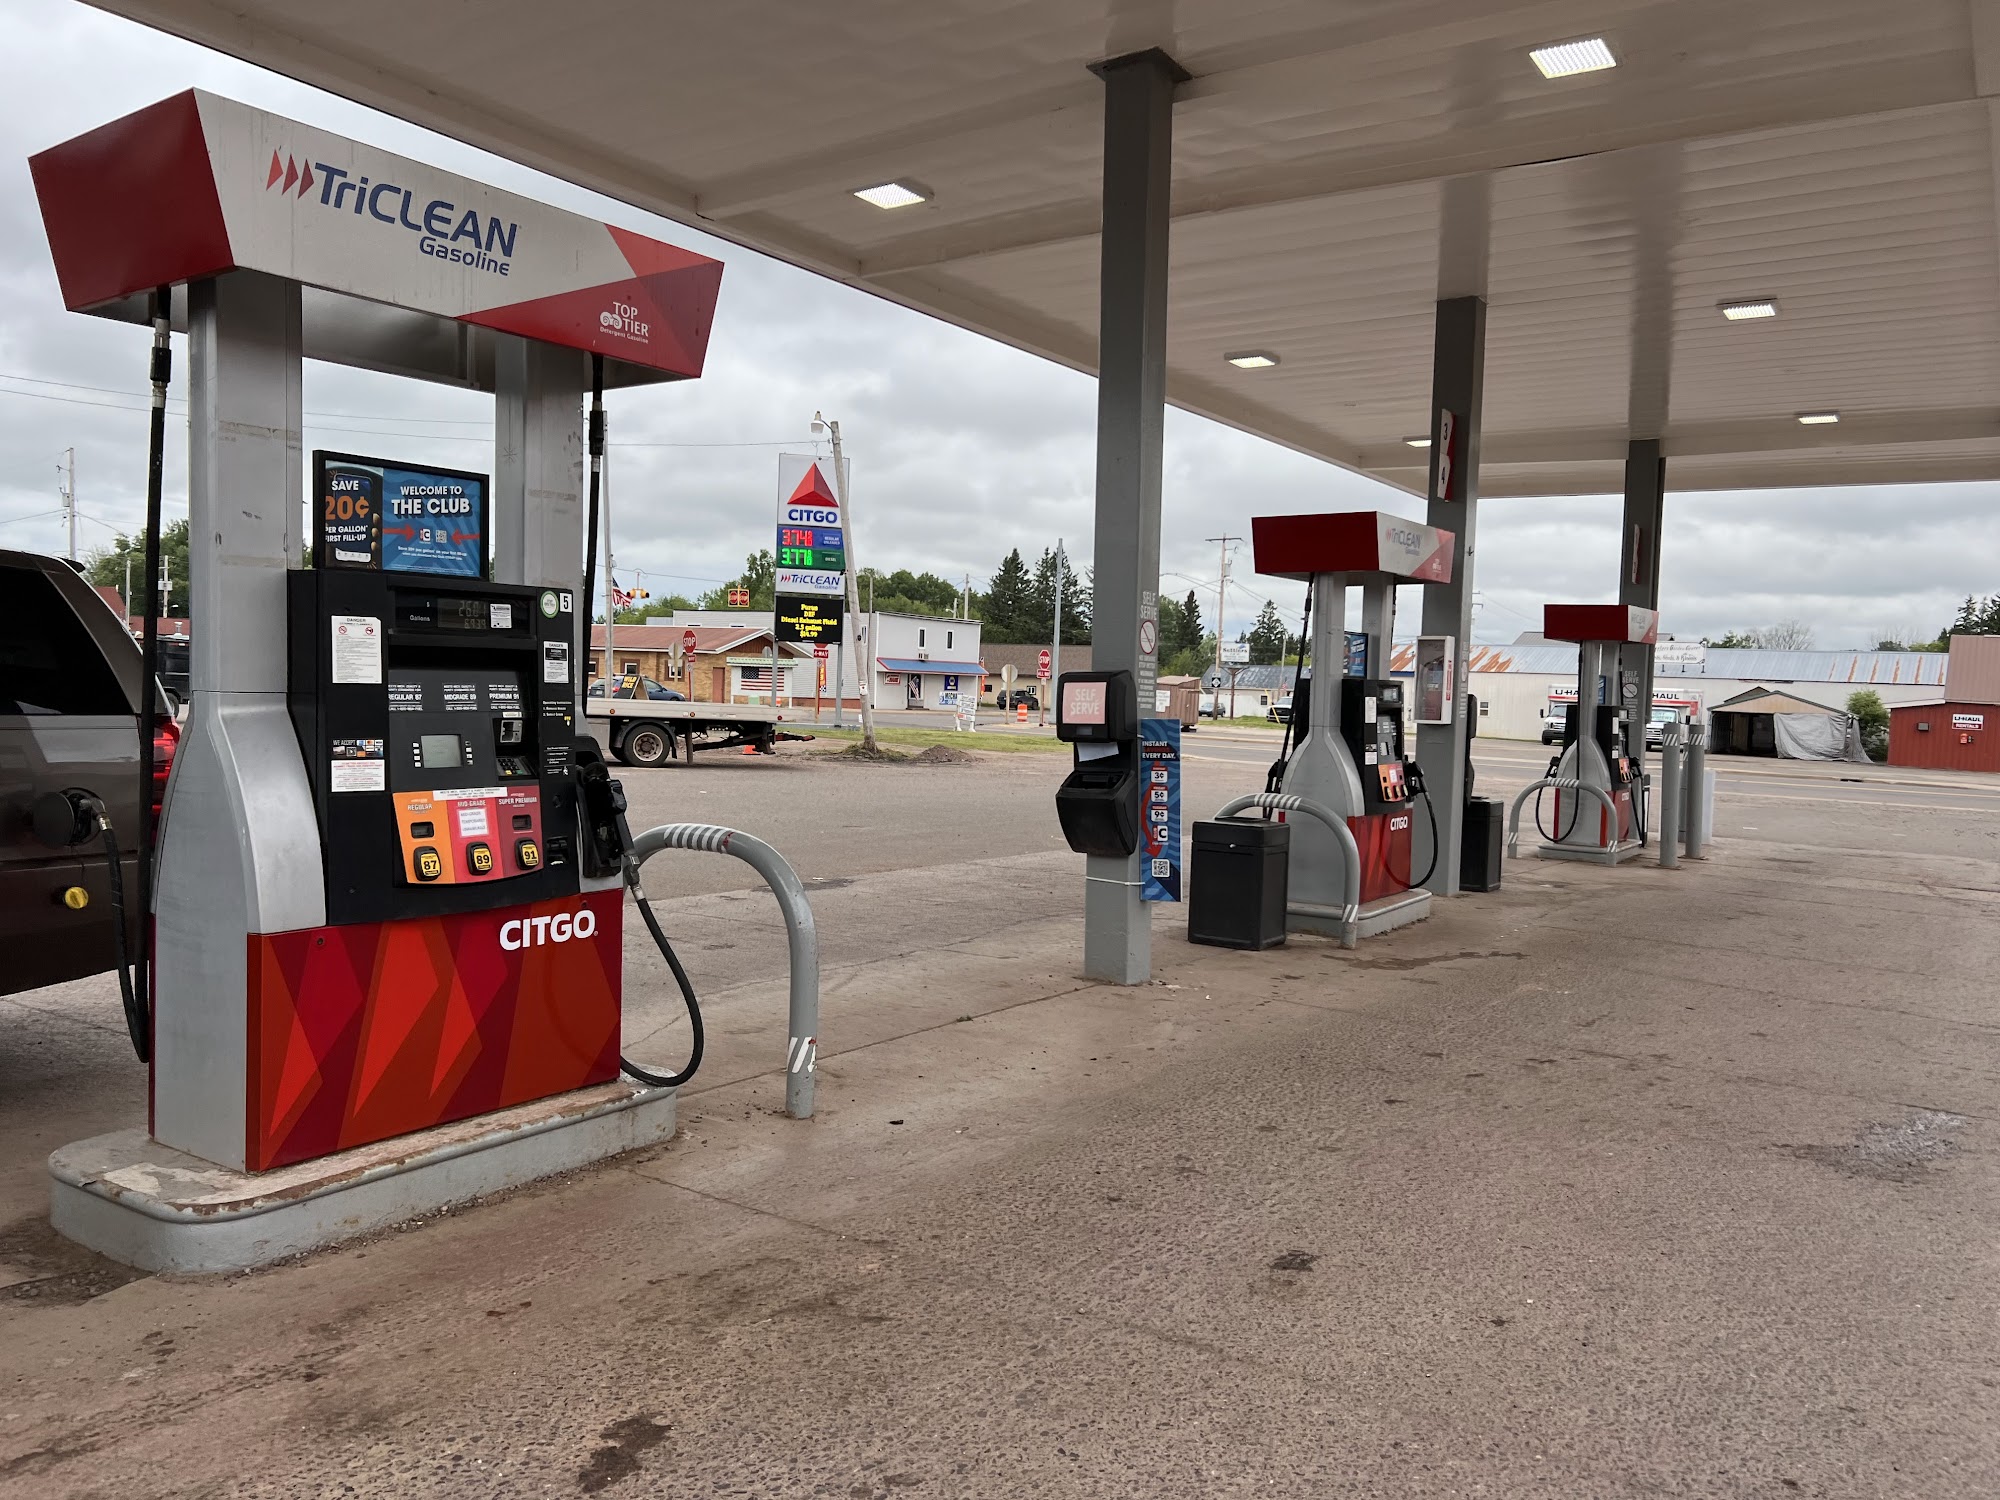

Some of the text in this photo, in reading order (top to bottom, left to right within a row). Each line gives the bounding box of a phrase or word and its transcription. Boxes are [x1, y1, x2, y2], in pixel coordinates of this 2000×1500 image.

[314, 162, 518, 258] TriCLEAN
[419, 236, 510, 277] Gasoline
[612, 301, 638, 320] TOP
[622, 318, 649, 337] TIER
[331, 480, 359, 491] SAVE
[400, 485, 463, 496] WELCOME TO
[391, 497, 470, 515] THE CLUB
[788, 509, 838, 523] CITGO
[791, 574, 840, 586] TriCLEAN
[563, 595, 569, 610] 5
[1142, 591, 1156, 605] SELF
[409, 614, 431, 622] Gallons
[1140, 605, 1157, 621] SERVE
[683, 637, 695, 646] STOP
[1039, 655, 1051, 664] STOP
[1074, 688, 1096, 701] SELF
[1070, 702, 1100, 715] SERVE
[1154, 771, 1164, 780] 3¢
[514, 796, 538, 804] PREMIUM
[1154, 791, 1164, 799] 5¢
[407, 803, 433, 811] REGULAR
[1154, 810, 1164, 819] 9¢
[1390, 815, 1408, 831] CITGO
[476, 854, 490, 864] 89
[524, 850, 537, 860] 91
[423, 860, 437, 870] 87
[499, 909, 597, 951] CITGO
